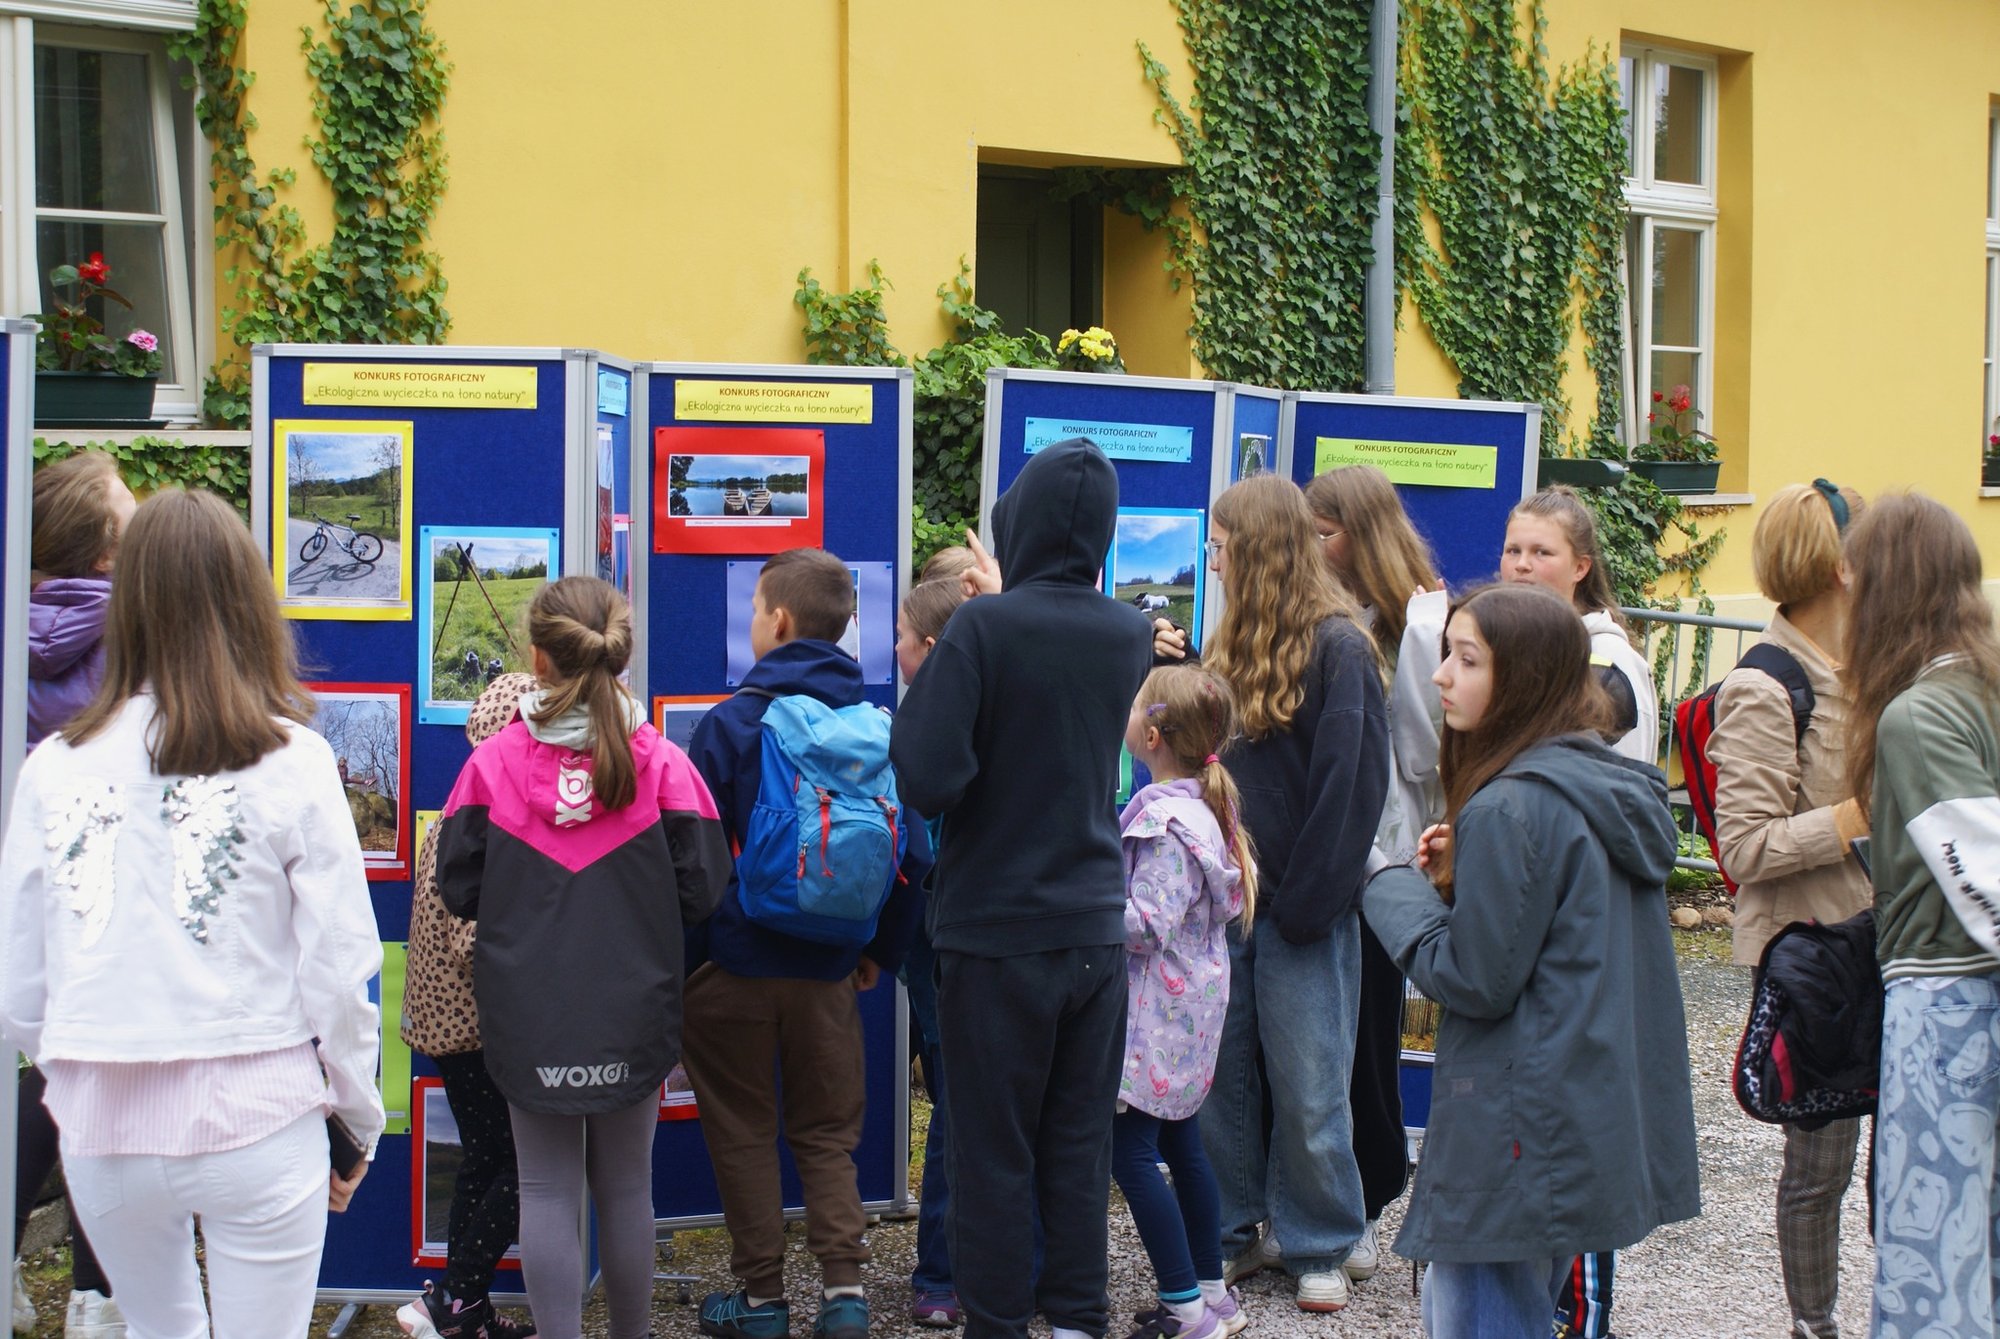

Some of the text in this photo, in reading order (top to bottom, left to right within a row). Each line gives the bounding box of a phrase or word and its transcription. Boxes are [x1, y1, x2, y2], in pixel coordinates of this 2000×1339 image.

[353, 371, 486, 383] KONKURS FOTOGRAFICZNY
[383, 388, 438, 401] wycieczka
[442, 391, 454, 399] na
[458, 389, 481, 400] łono
[719, 388, 830, 399] KONKURS FOTOGRAFICZNY
[744, 402, 791, 415] wycieczka
[807, 403, 827, 413] łono
[1062, 425, 1158, 439] KONKURS FOTOGRAFICZNY
[1126, 444, 1136, 452] na
[1138, 442, 1154, 453] łono
[1354, 444, 1458, 456] KONKURS FOTOGRAFICZNY
[1376, 455, 1420, 469] wycieczka
[1422, 460, 1433, 468] na
[1435, 458, 1454, 470] łono
